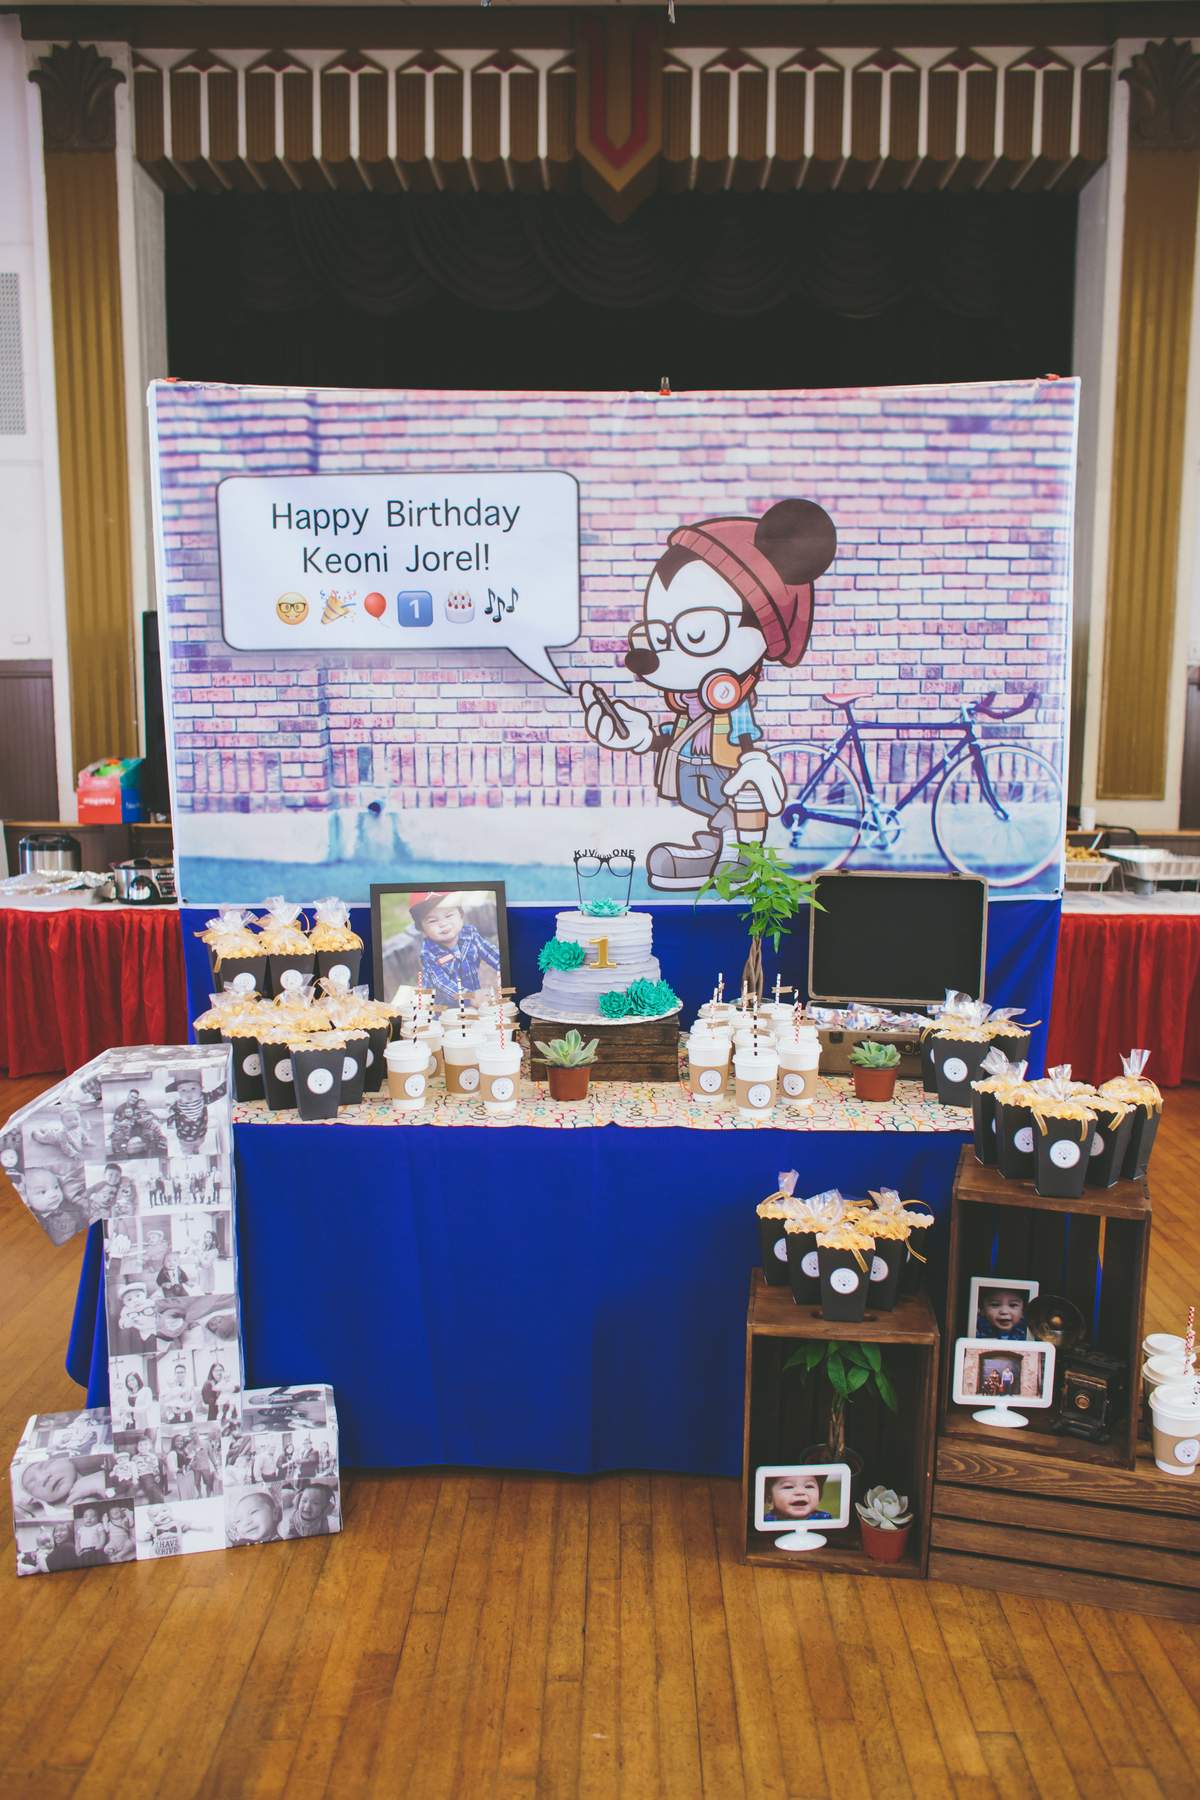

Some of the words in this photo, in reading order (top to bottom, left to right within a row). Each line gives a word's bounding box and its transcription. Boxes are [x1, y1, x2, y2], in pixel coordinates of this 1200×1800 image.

[272, 502, 370, 536] Happy
[386, 497, 521, 533] Birthday
[303, 545, 389, 574] Keoni
[405, 542, 490, 573] Jorel!
[409, 599, 420, 619] 1
[574, 849, 596, 858] KJV
[612, 849, 635, 858] ONE
[589, 936, 617, 969] 1
